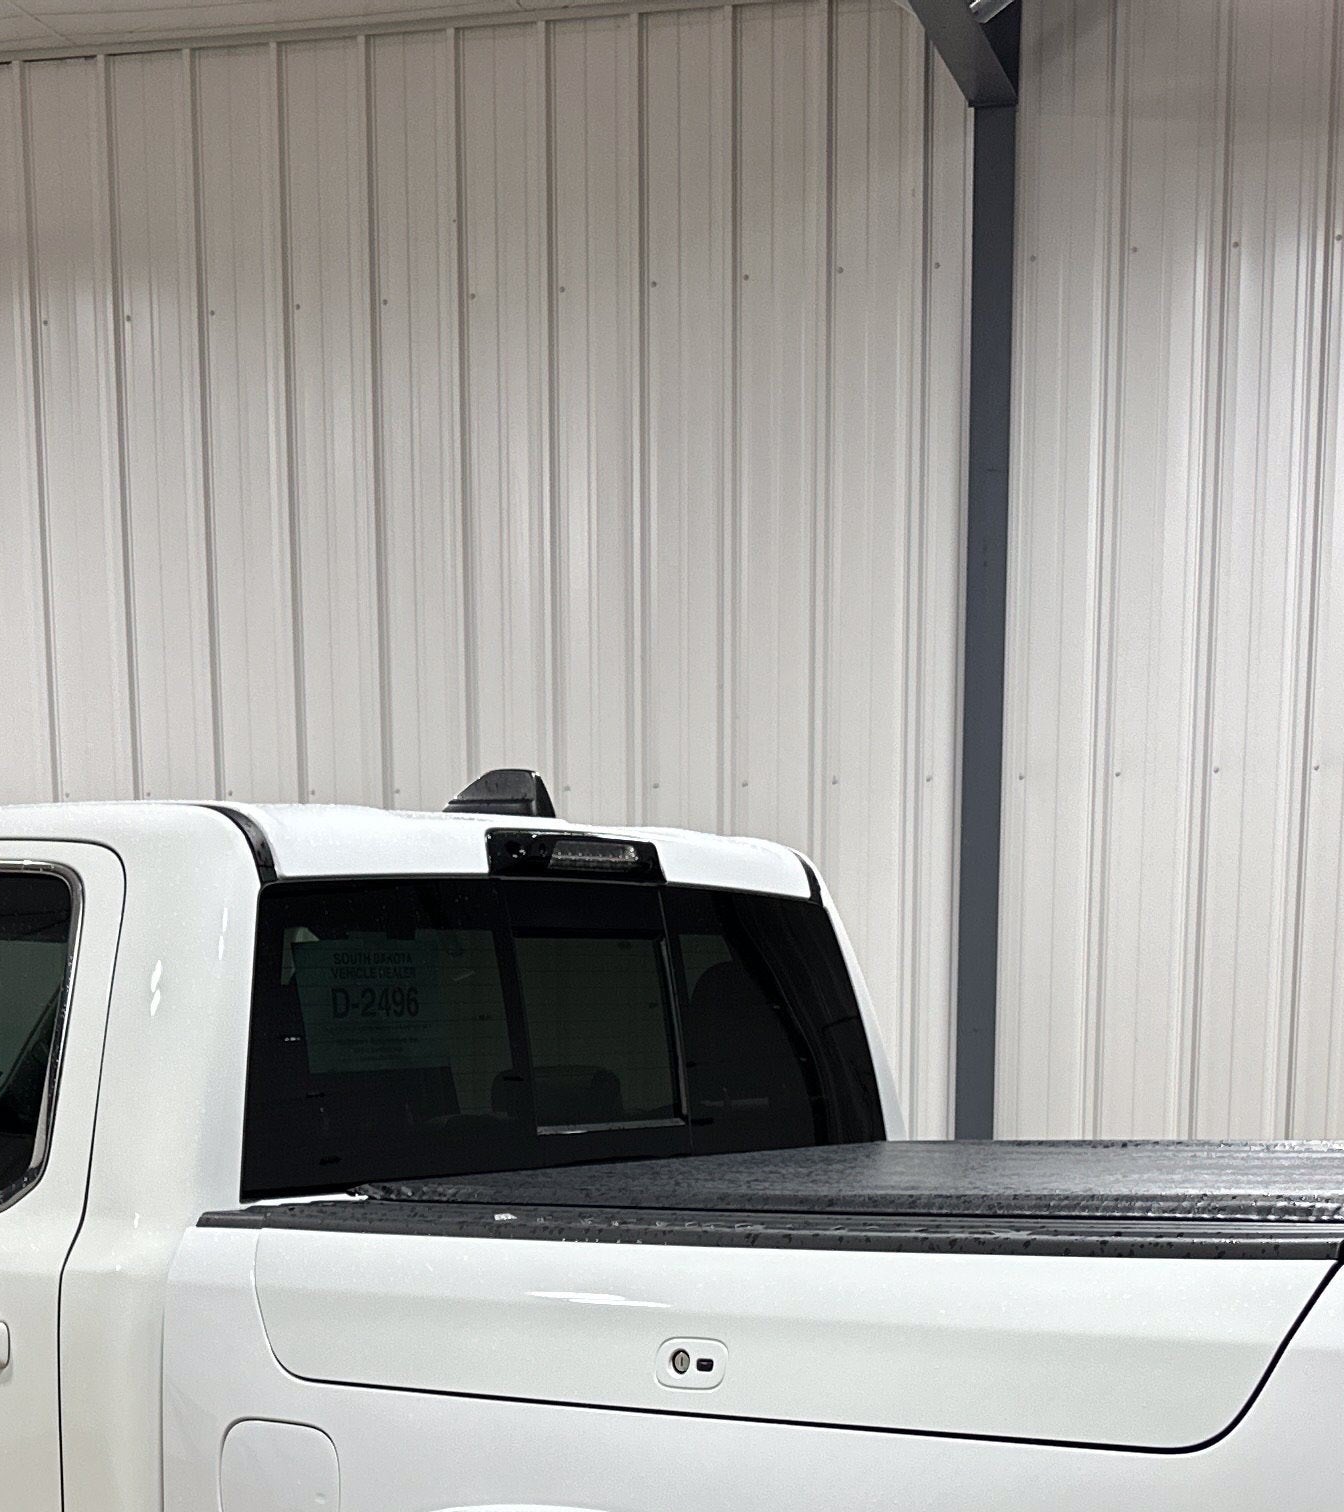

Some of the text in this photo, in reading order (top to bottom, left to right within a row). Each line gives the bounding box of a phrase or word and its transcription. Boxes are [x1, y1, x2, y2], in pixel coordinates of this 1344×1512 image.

[333, 952, 412, 965] SOUTH DAKOTA
[331, 986, 419, 1018] D-2496
